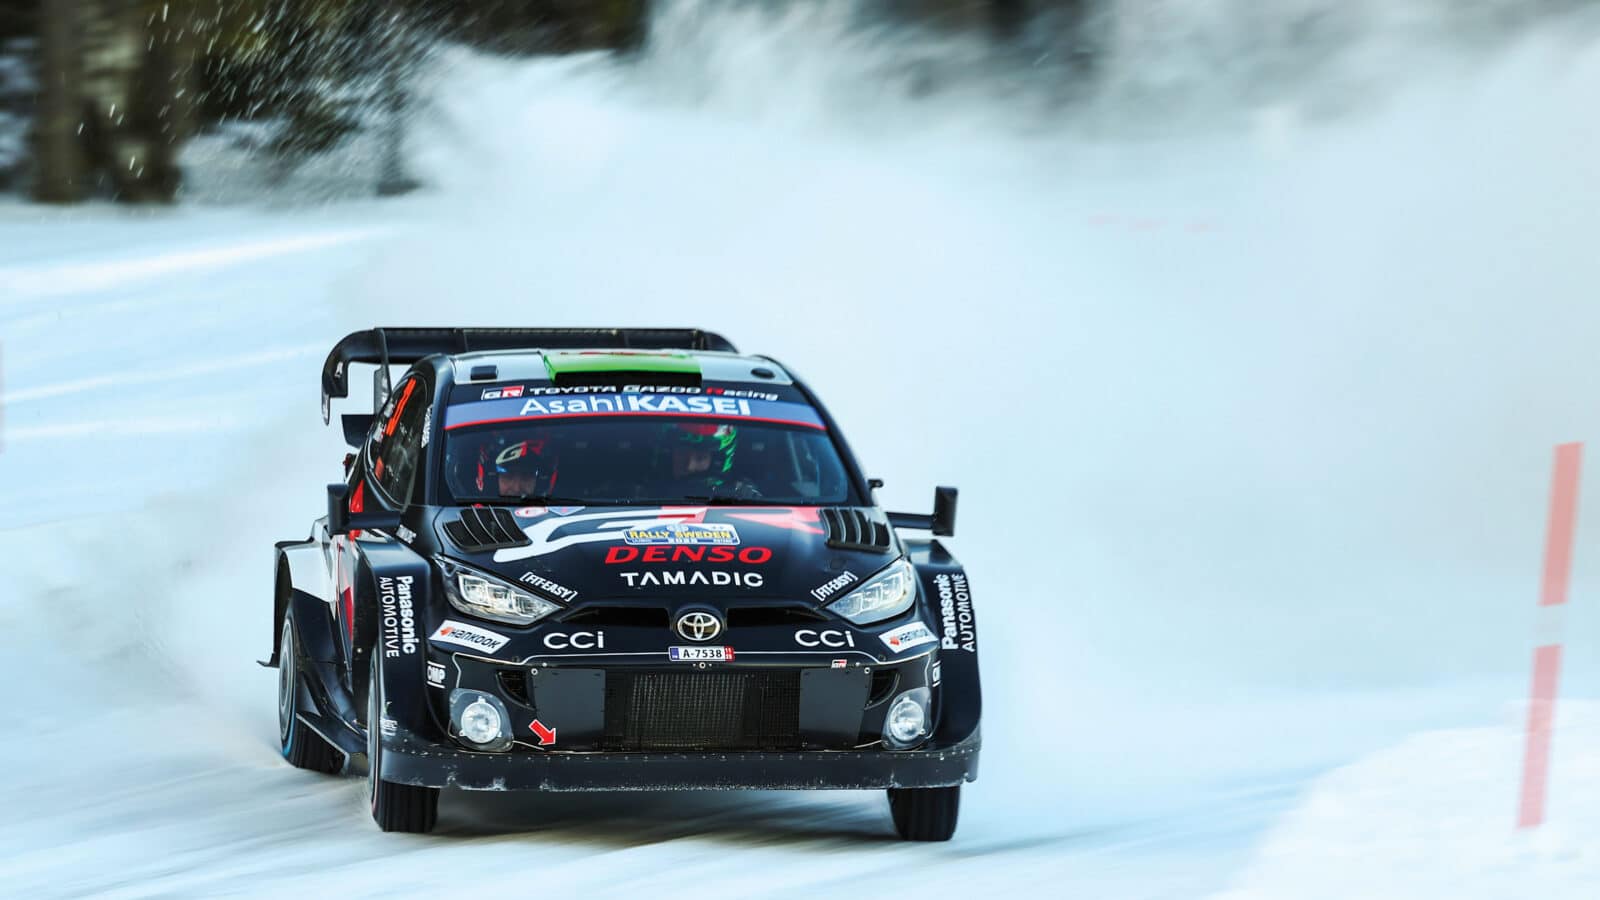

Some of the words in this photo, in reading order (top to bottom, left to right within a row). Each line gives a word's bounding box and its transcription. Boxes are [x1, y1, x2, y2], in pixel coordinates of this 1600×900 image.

[530, 386, 616, 396] TOYOTA
[623, 384, 701, 395] GAZOO
[706, 387, 779, 401] Racing
[629, 529, 669, 539] RALLY
[674, 530, 731, 539] SWEDEN
[605, 546, 773, 564] DENSO
[620, 571, 764, 587] TAMADIC
[380, 576, 400, 658] AUTOMOTIVE
[396, 575, 419, 654] Panasonic
[933, 574, 959, 650] Panasonic
[951, 573, 976, 653] AUTOMOTIVE
[683, 648, 722, 658] A-7538
